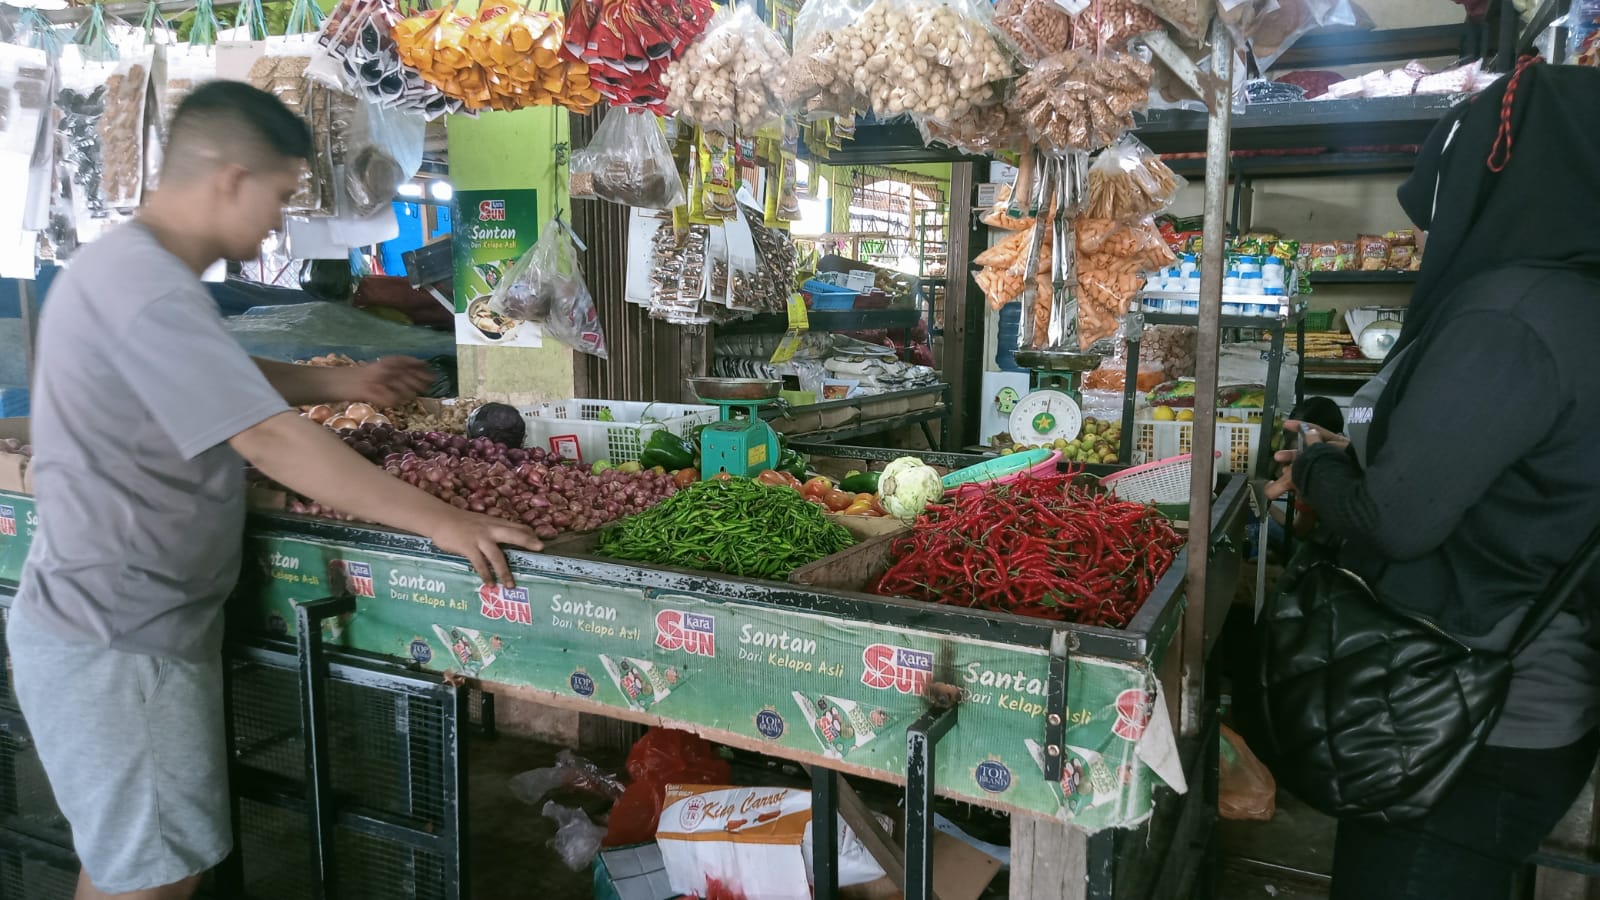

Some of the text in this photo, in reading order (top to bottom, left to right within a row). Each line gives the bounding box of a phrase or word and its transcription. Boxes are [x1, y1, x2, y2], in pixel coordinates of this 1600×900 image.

[479, 200, 505, 221] SUN
[471, 225, 516, 240] Santan
[389, 569, 446, 594] Santan
[390, 589, 468, 611] Dari Kelapa Asli
[480, 583, 532, 625] SUN
[504, 588, 526, 601] kara
[551, 593, 617, 622] Santan
[552, 615, 641, 641] Dari Kelapa Asli
[655, 609, 715, 658] SUN
[686, 614, 710, 630] kara
[738, 623, 817, 656] Santan
[738, 647, 844, 678] Dari Kelapa Asli
[860, 643, 934, 697] SUN
[899, 650, 929, 667] kara
[759, 714, 781, 726] TOP
[979, 765, 1008, 779] TOP
[700, 788, 788, 821] King Carrot
